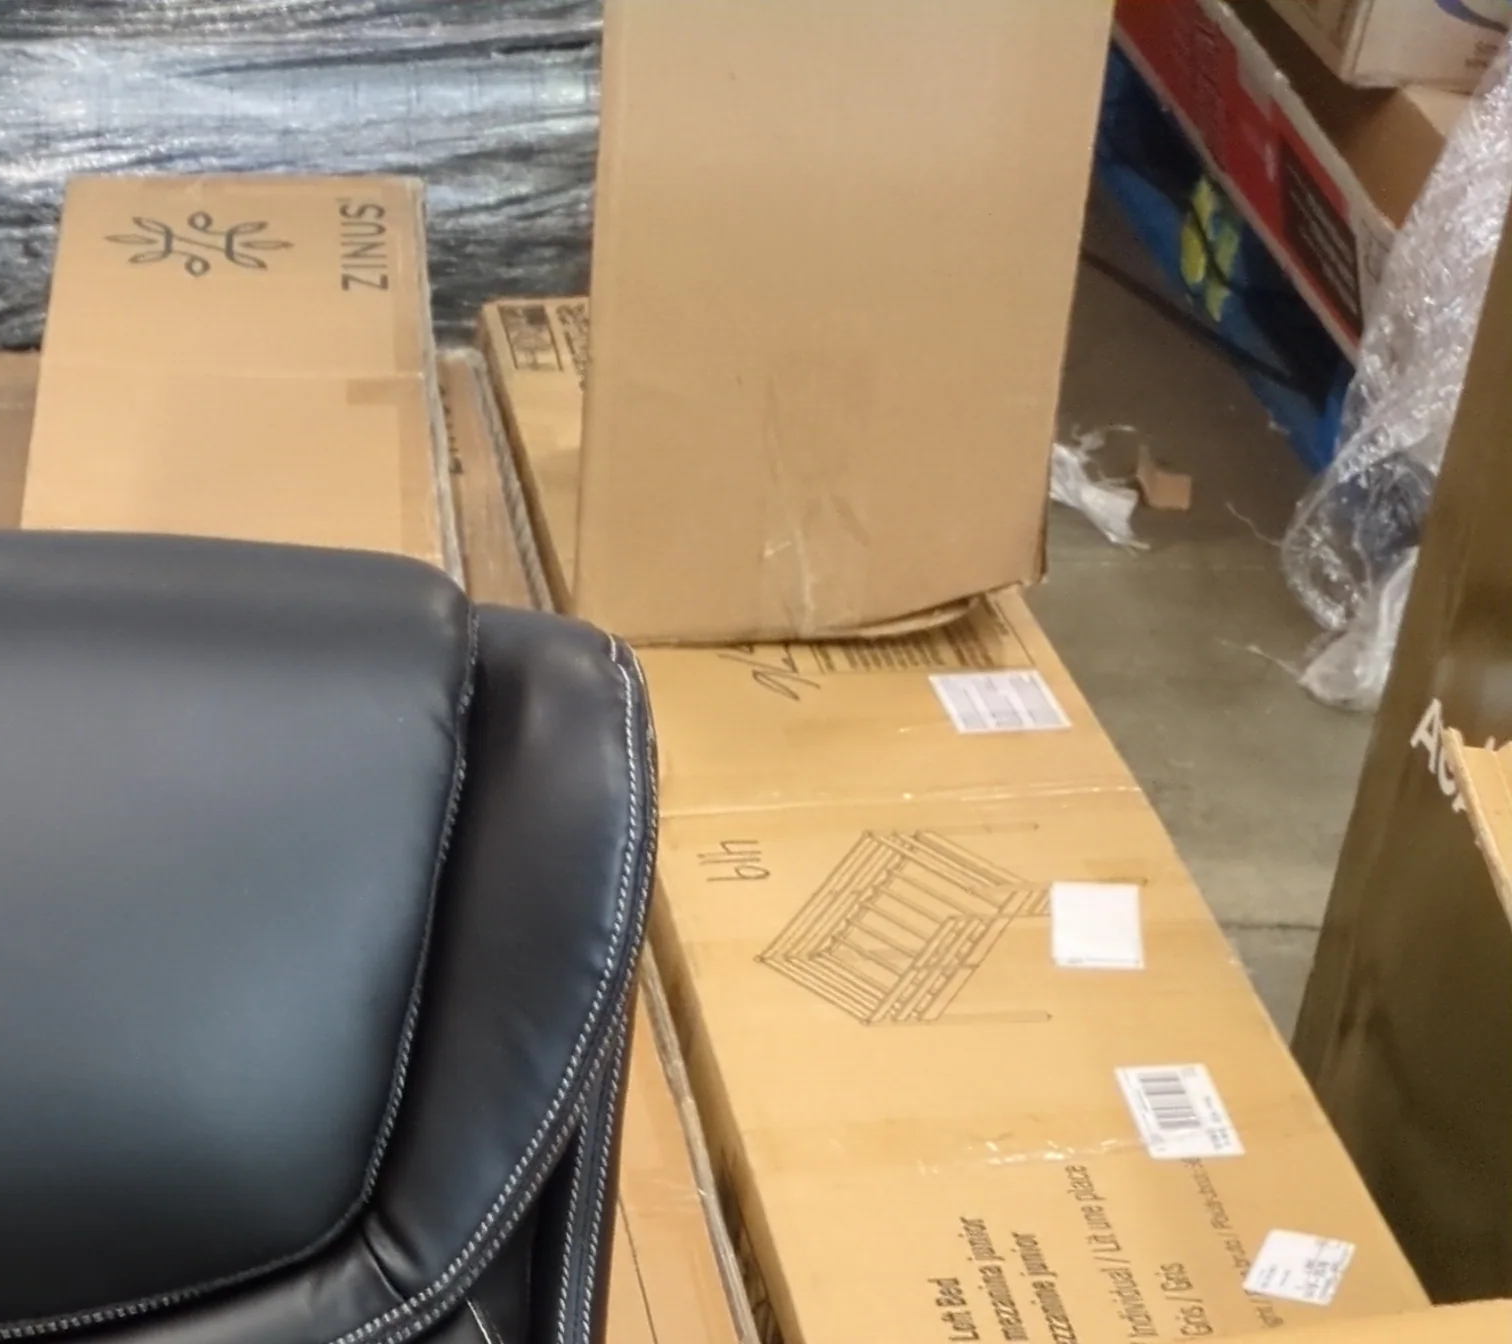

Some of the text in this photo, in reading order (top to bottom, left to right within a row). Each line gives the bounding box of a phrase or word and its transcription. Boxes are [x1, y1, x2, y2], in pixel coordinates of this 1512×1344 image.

[339, 202, 389, 291] ZINUS
[1063, 1164, 1107, 1202] place
[1080, 1204, 1113, 1230] une
[958, 1216, 1006, 1262] junior
[1009, 1231, 1059, 1278] junior
[927, 1277, 967, 1307] Bed
[1153, 1262, 1194, 1292] Gris
[1099, 1266, 1160, 1338] Individual
[941, 1310, 980, 1341] Loft
[1174, 1306, 1215, 1337] Gris
